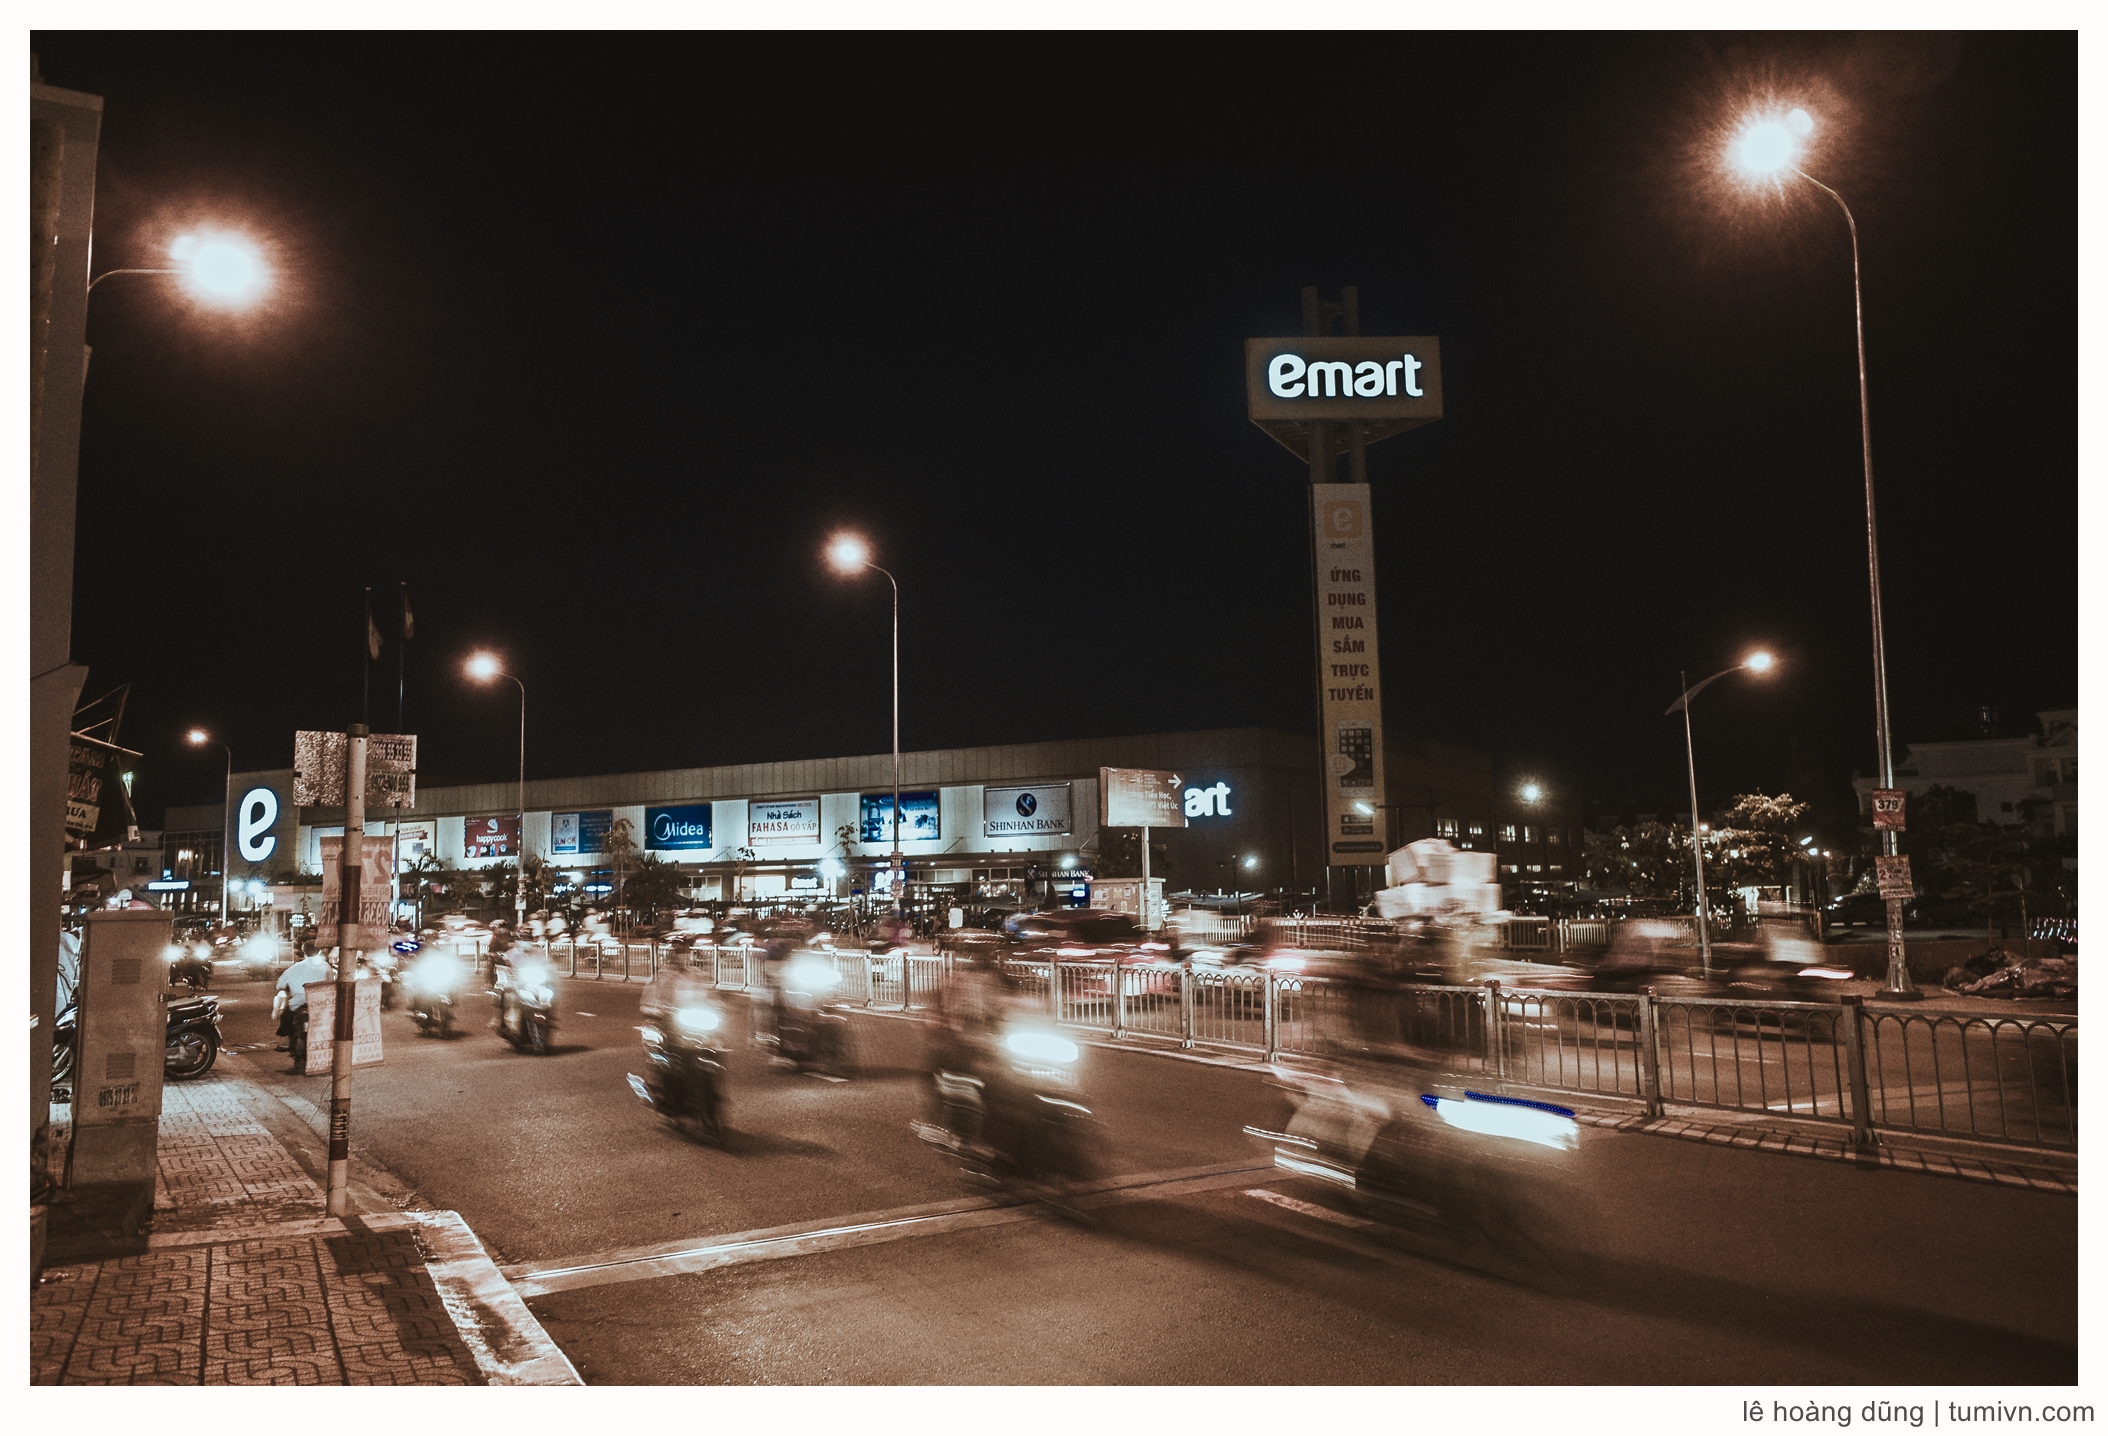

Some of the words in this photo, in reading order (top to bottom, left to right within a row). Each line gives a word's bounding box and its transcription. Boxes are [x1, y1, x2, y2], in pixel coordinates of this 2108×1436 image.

[1267, 352, 1425, 399] emart
[1330, 566, 1361, 582] ỨNG
[1327, 592, 1366, 610] DỤNG
[1332, 616, 1364, 630] MUA
[1333, 634, 1365, 653] SẮM
[1331, 664, 1370, 681] TRỰC
[1328, 683, 1374, 701] TUYẾN
[1878, 799, 1898, 810] 379
[766, 809, 781, 820] Nhà
[783, 809, 802, 819] Sách
[238, 787, 279, 863] e
[662, 822, 704, 837] Midea
[751, 821, 789, 833] FAHASA
[790, 821, 801, 832] GÒ
[802, 819, 817, 831] VẤP
[989, 820, 1035, 832] SHINHAN
[1036, 819, 1065, 830] BANK
[1070, 869, 1090, 878] BANK
